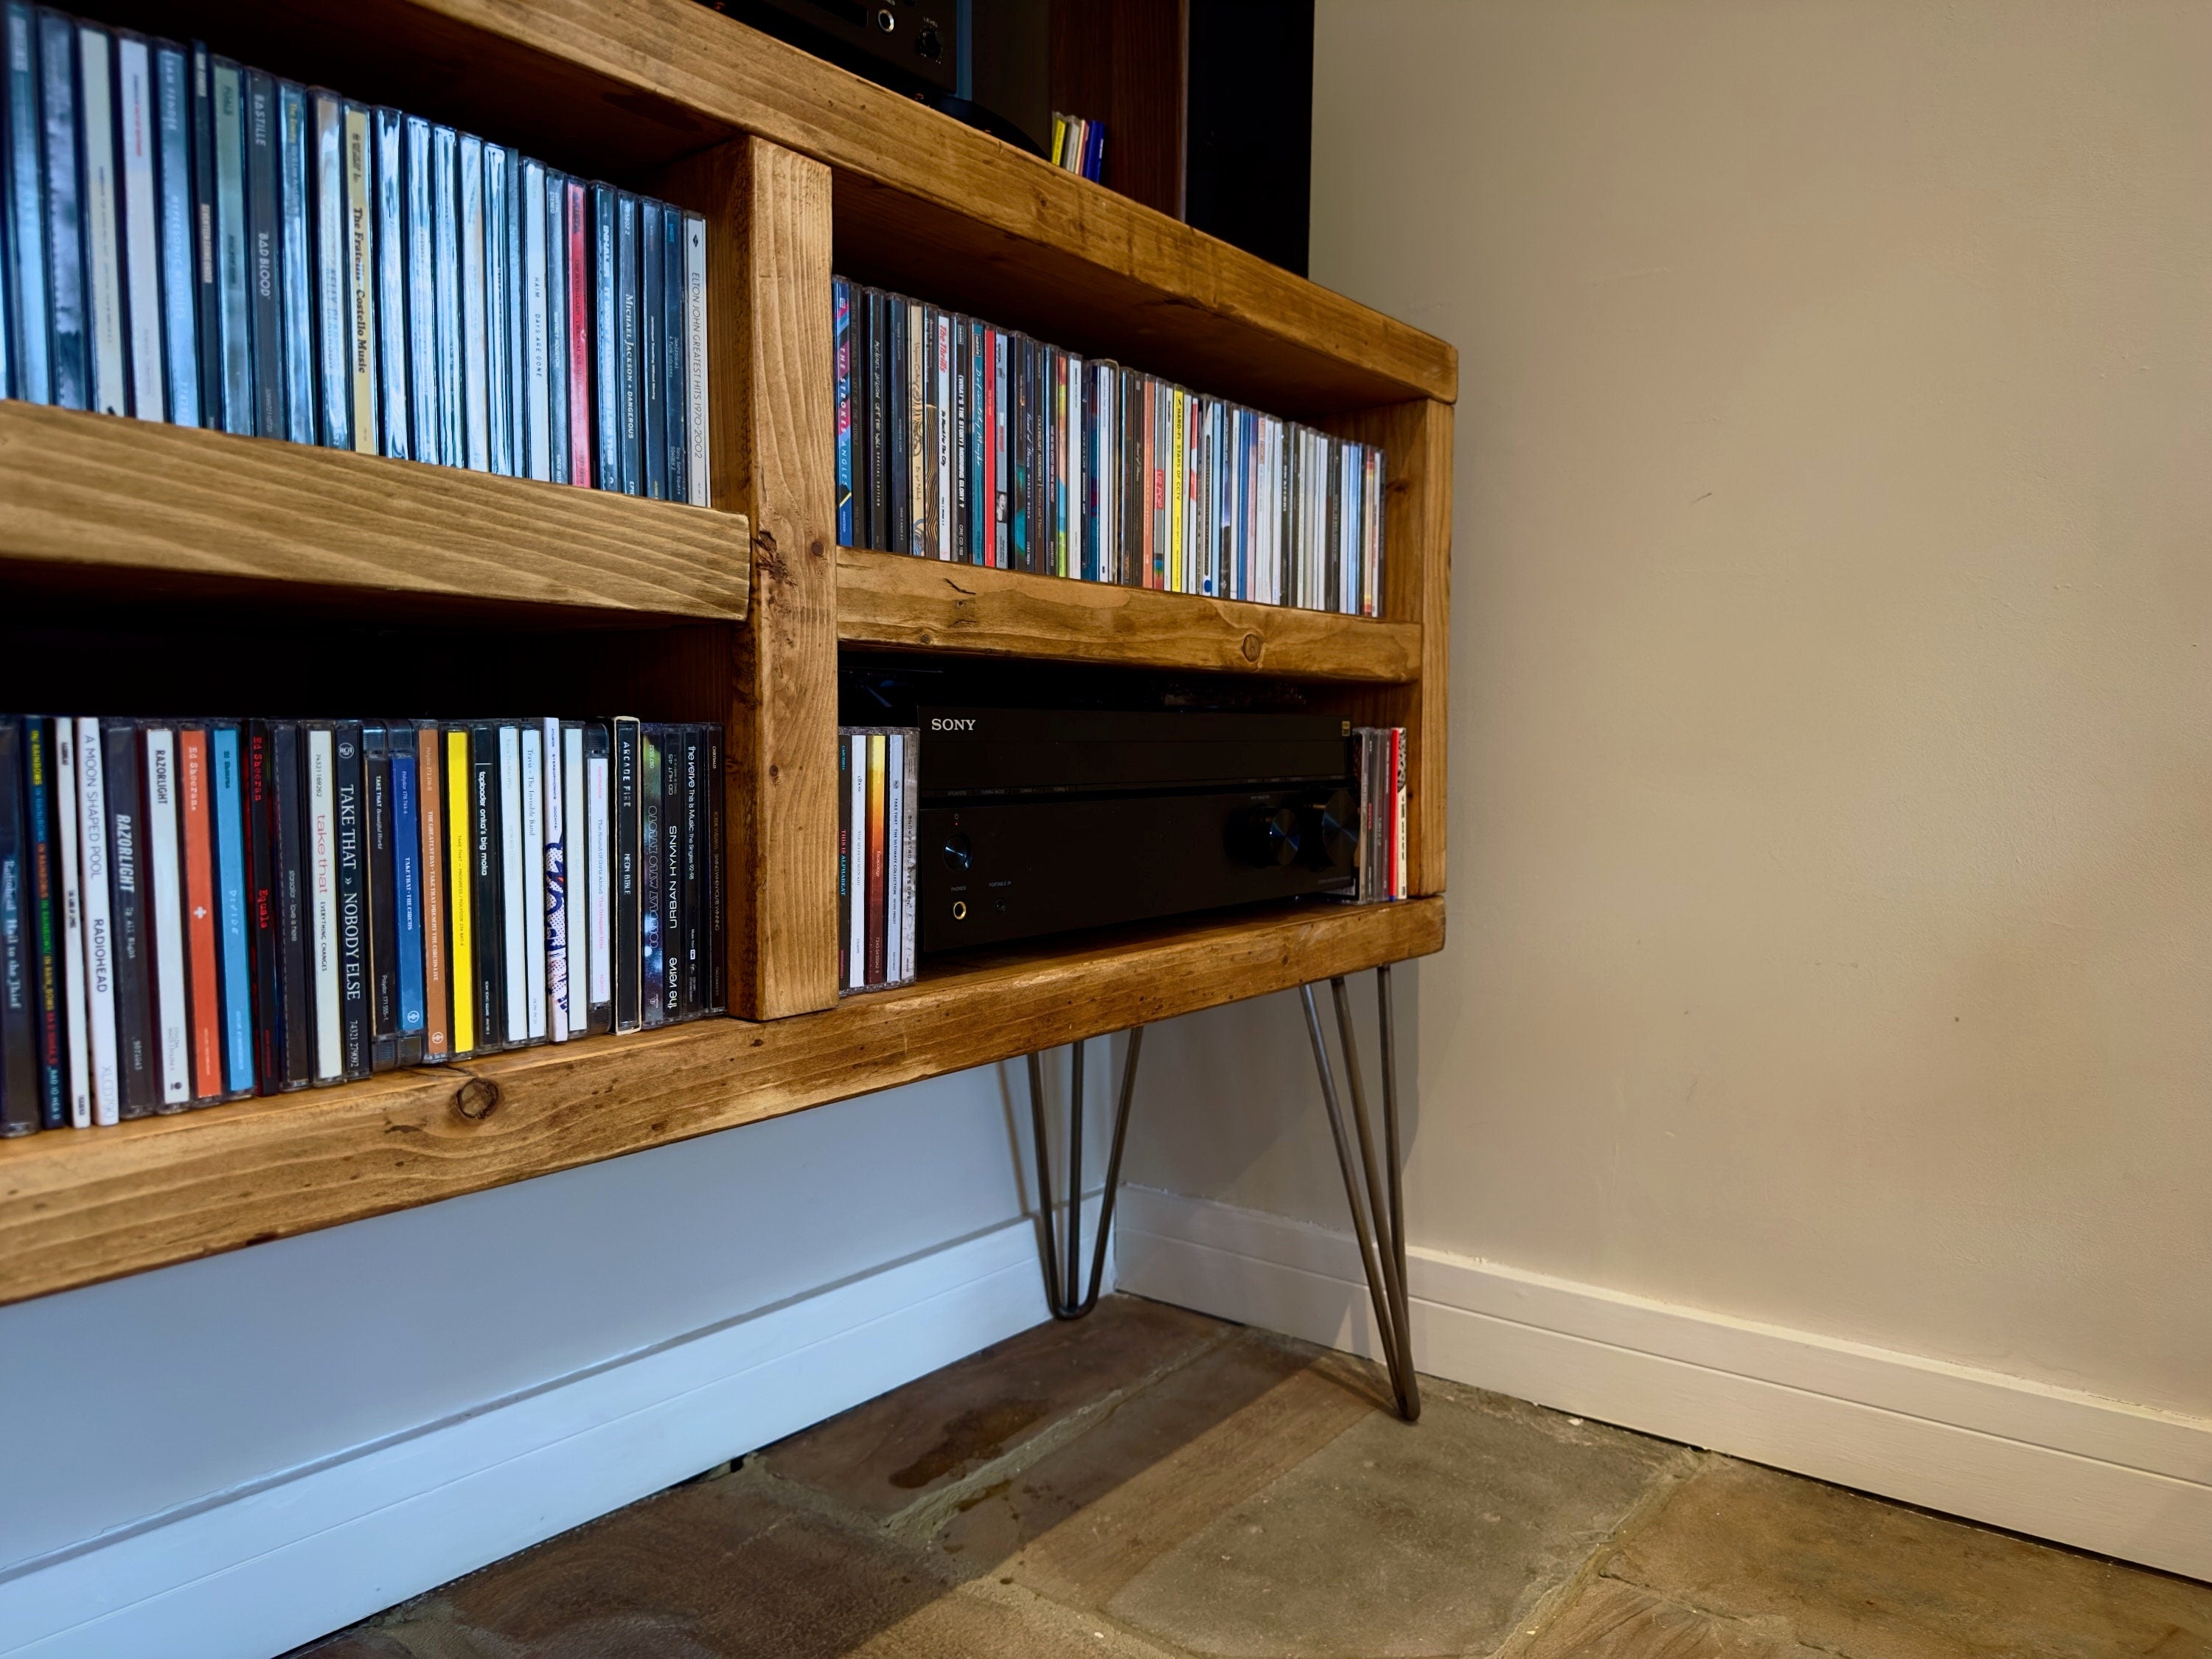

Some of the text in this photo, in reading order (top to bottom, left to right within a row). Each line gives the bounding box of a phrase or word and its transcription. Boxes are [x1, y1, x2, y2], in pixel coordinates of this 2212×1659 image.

[254, 94, 265, 146] BASTILLE
[354, 207, 364, 229] The
[356, 289, 366, 335] Costello
[358, 339, 366, 373] Music
[692, 273, 703, 459] ELTON JOHN GREATEST HITS 1970-2002
[84, 735, 95, 744] A
[931, 718, 976, 731] SONY
[85, 748, 97, 787] MOON
[189, 746, 198, 759] Ed
[622, 741, 631, 782] ARCADE
[688, 746, 697, 760] the
[156, 750, 167, 804] RAZORLIGHT
[478, 771, 487, 807] toploader
[688, 762, 696, 788] verve
[623, 785, 631, 807] FIRE
[688, 789, 696, 802] This
[87, 792, 100, 842] SHAPED
[253, 736, 269, 928] Ed Sheeran Equals
[316, 814, 328, 855] take
[479, 808, 487, 835] onka's
[116, 814, 135, 894] RAZORLIGHT
[479, 837, 488, 850] big
[90, 846, 102, 880] POOL
[317, 859, 329, 894] that
[288, 870, 297, 899] starsailor
[290, 904, 298, 919] love
[341, 784, 361, 1068] TAKE THAT NOBODY ELSE 74321 279092
[667, 826, 678, 1009] the verve URBAN HYMNS
[3, 860, 21, 1009] Radiohead Hail to the Thief
[290, 926, 299, 942] here
[94, 919, 108, 993] RADIOHEAD
